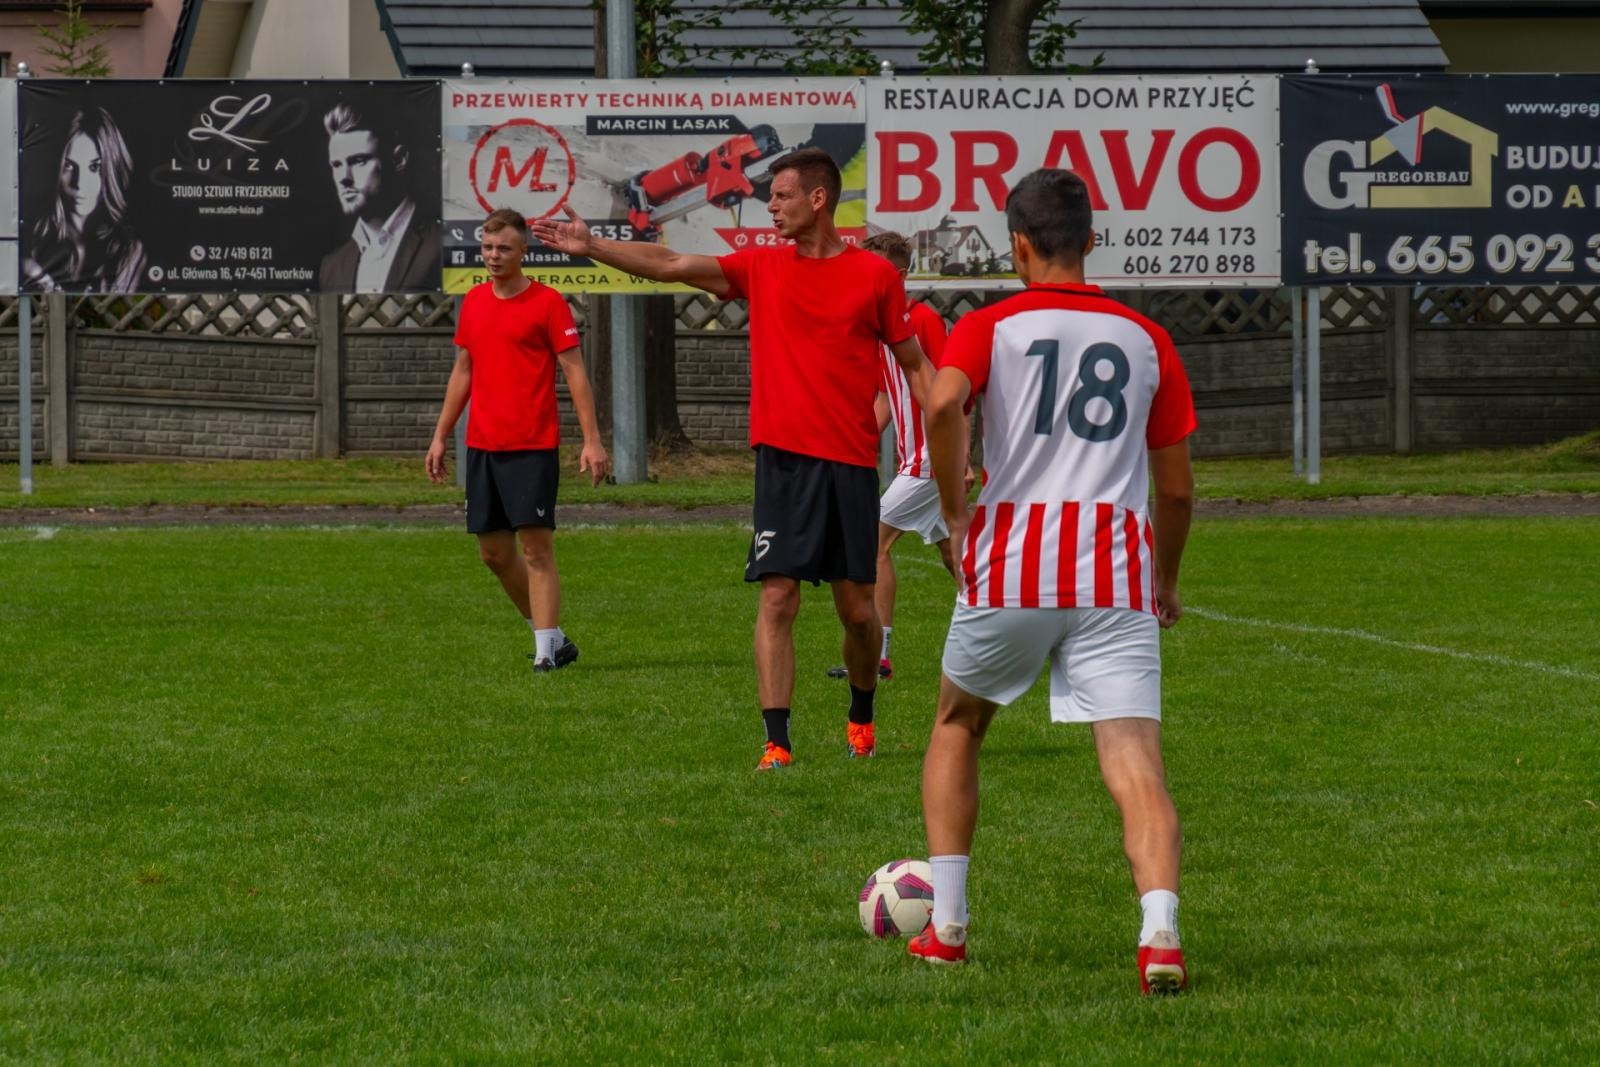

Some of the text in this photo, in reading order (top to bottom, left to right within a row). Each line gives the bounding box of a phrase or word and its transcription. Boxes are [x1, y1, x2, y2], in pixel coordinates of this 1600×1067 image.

[452, 91, 856, 110] PRZEWIERTY TECHNIKĄ DIAMENTOWĄ
[884, 80, 1255, 112] RESTAURACJA DOM PRZYJĘĆ
[1505, 103, 1600, 118] www.greg
[597, 118, 730, 130] MARCIN LASAK
[171, 158, 290, 171] LUIZA
[875, 127, 1261, 213] BRAVO
[172, 185, 290, 198] STUDIO SZTUKI FRYZJERSKIEJ
[1506, 184, 1554, 209] OD
[1562, 184, 1586, 208] A
[199, 206, 264, 216] www.studio-luiza.pl
[590, 224, 633, 241] 635
[1093, 226, 1256, 247] el. 602 744 173
[208, 247, 222, 260] 32
[230, 247, 247, 260] 419
[249, 247, 260, 260] 61
[261, 247, 272, 260] 21
[1304, 233, 1376, 274] tel.
[1387, 235, 1475, 274] 665
[1486, 233, 1574, 274] 092
[1123, 254, 1255, 274] 606 270 898
[167, 266, 314, 281] ul. Główna 16, 47-451 Tworków
[1025, 339, 1131, 443] 18
